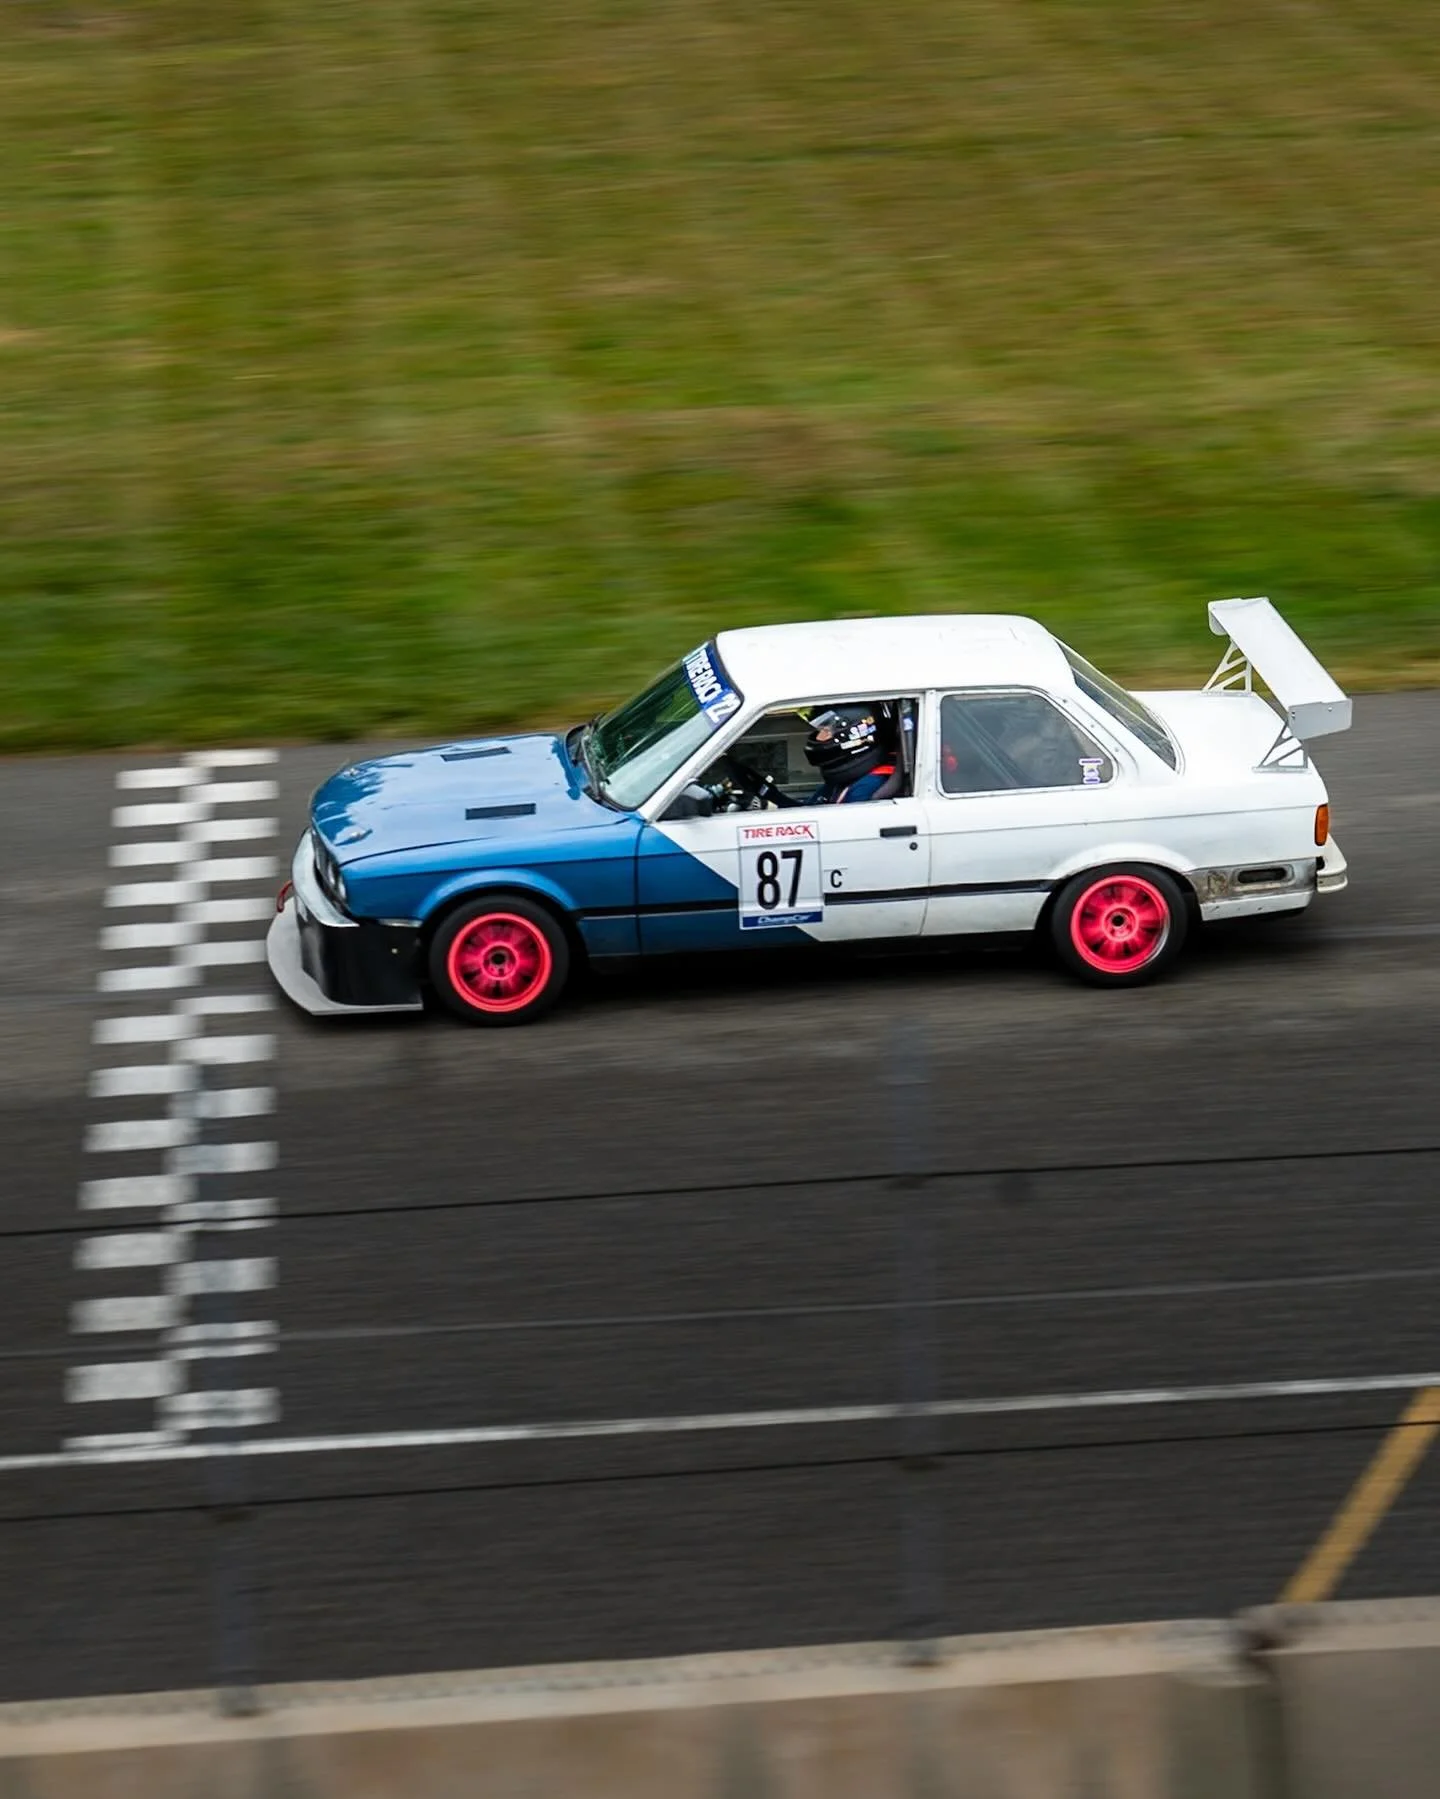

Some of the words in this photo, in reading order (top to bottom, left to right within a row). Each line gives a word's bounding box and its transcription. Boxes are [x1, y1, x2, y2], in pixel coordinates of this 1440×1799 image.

[743, 826, 774, 839] TIRE
[775, 824, 815, 839] RACK
[757, 849, 804, 910] 87
[830, 869, 843, 889] C
